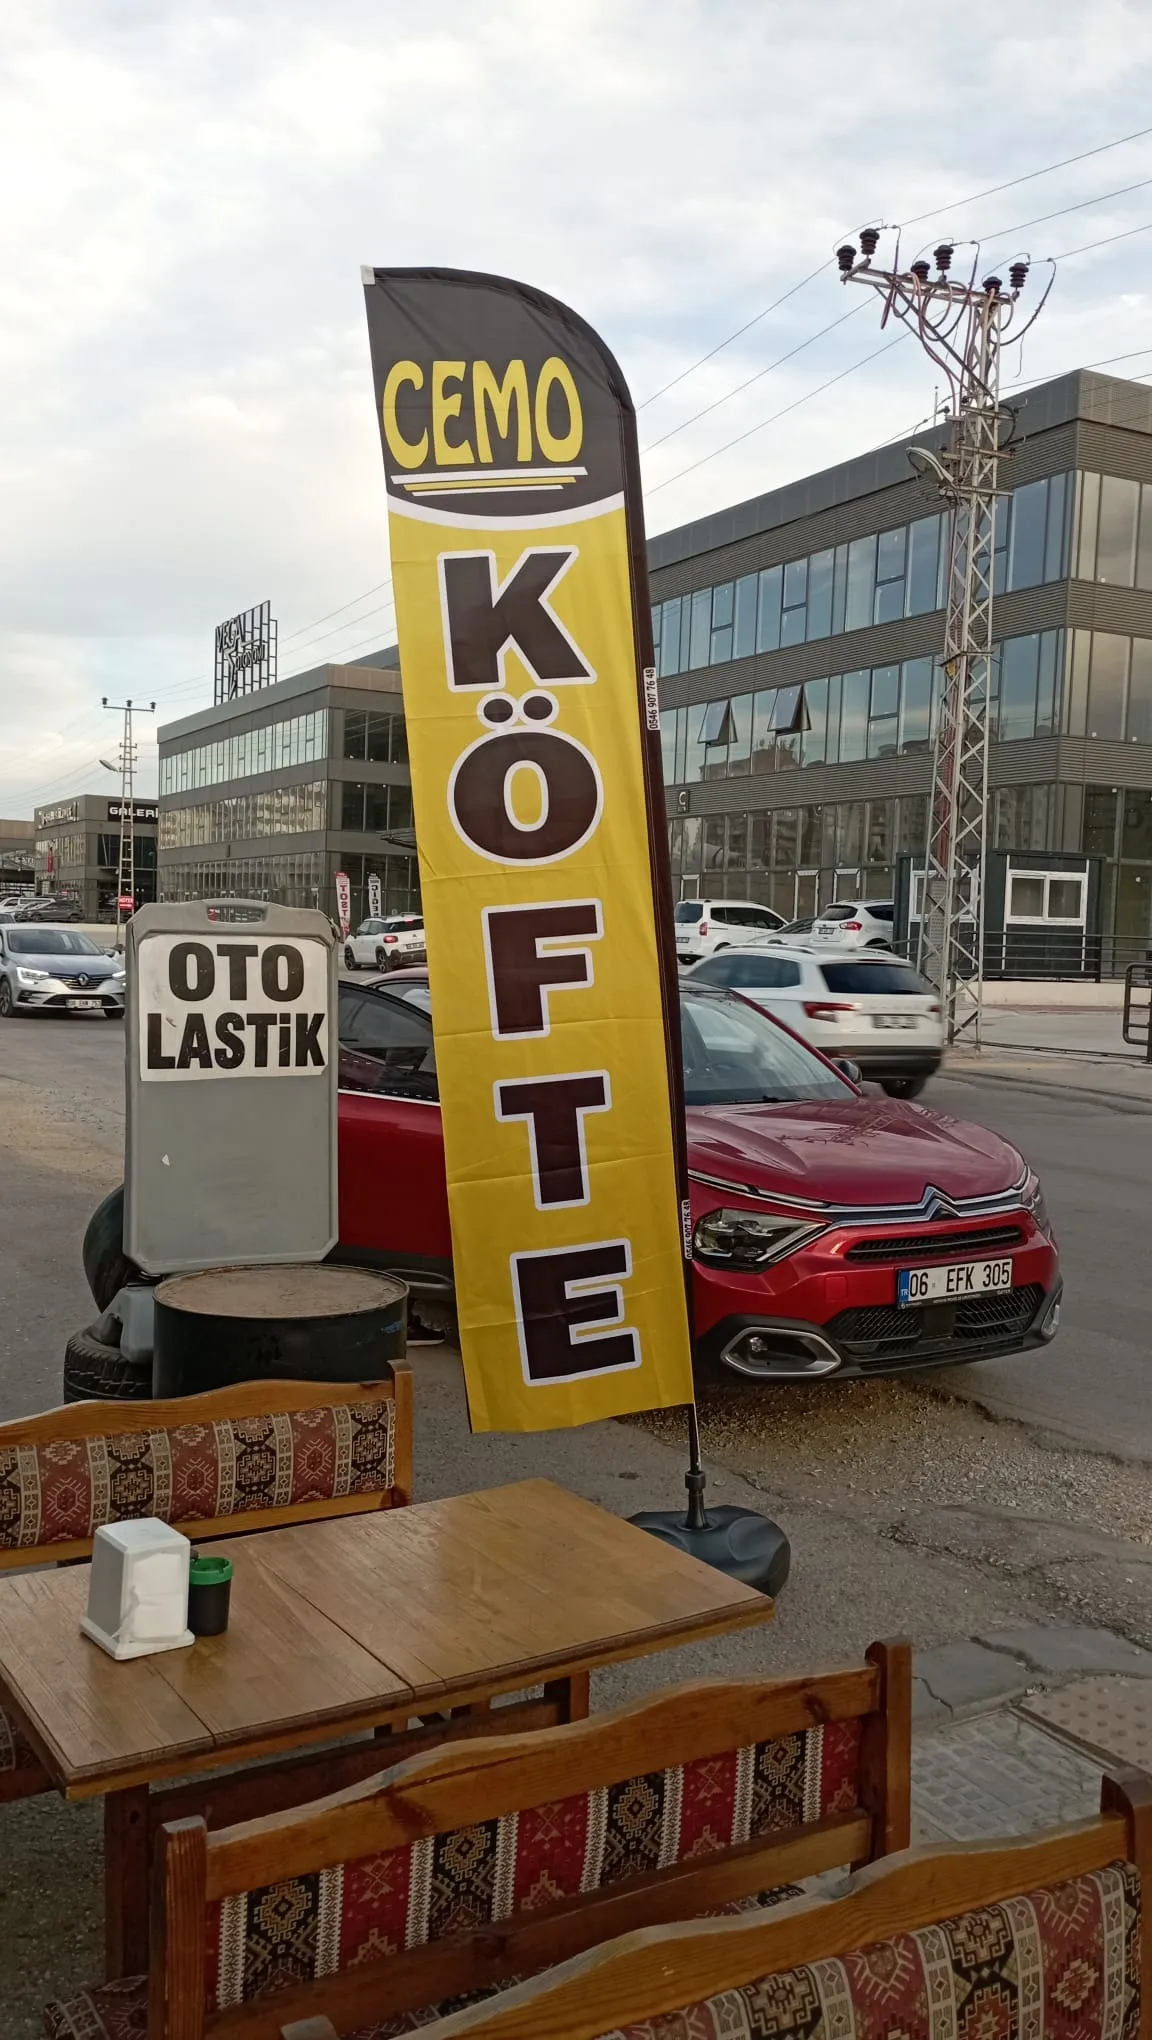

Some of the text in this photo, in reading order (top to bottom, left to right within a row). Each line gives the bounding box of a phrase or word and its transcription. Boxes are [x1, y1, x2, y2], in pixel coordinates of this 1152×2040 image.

[383, 356, 584, 469] CEMO
[645, 668, 658, 729] 0546 907 76 48
[168, 942, 304, 1002] OTO
[438, 546, 640, 1388] KÖFTE
[909, 1272, 929, 1298] 06
[946, 1265, 975, 1293] EFK
[982, 1261, 1011, 1288] 305
